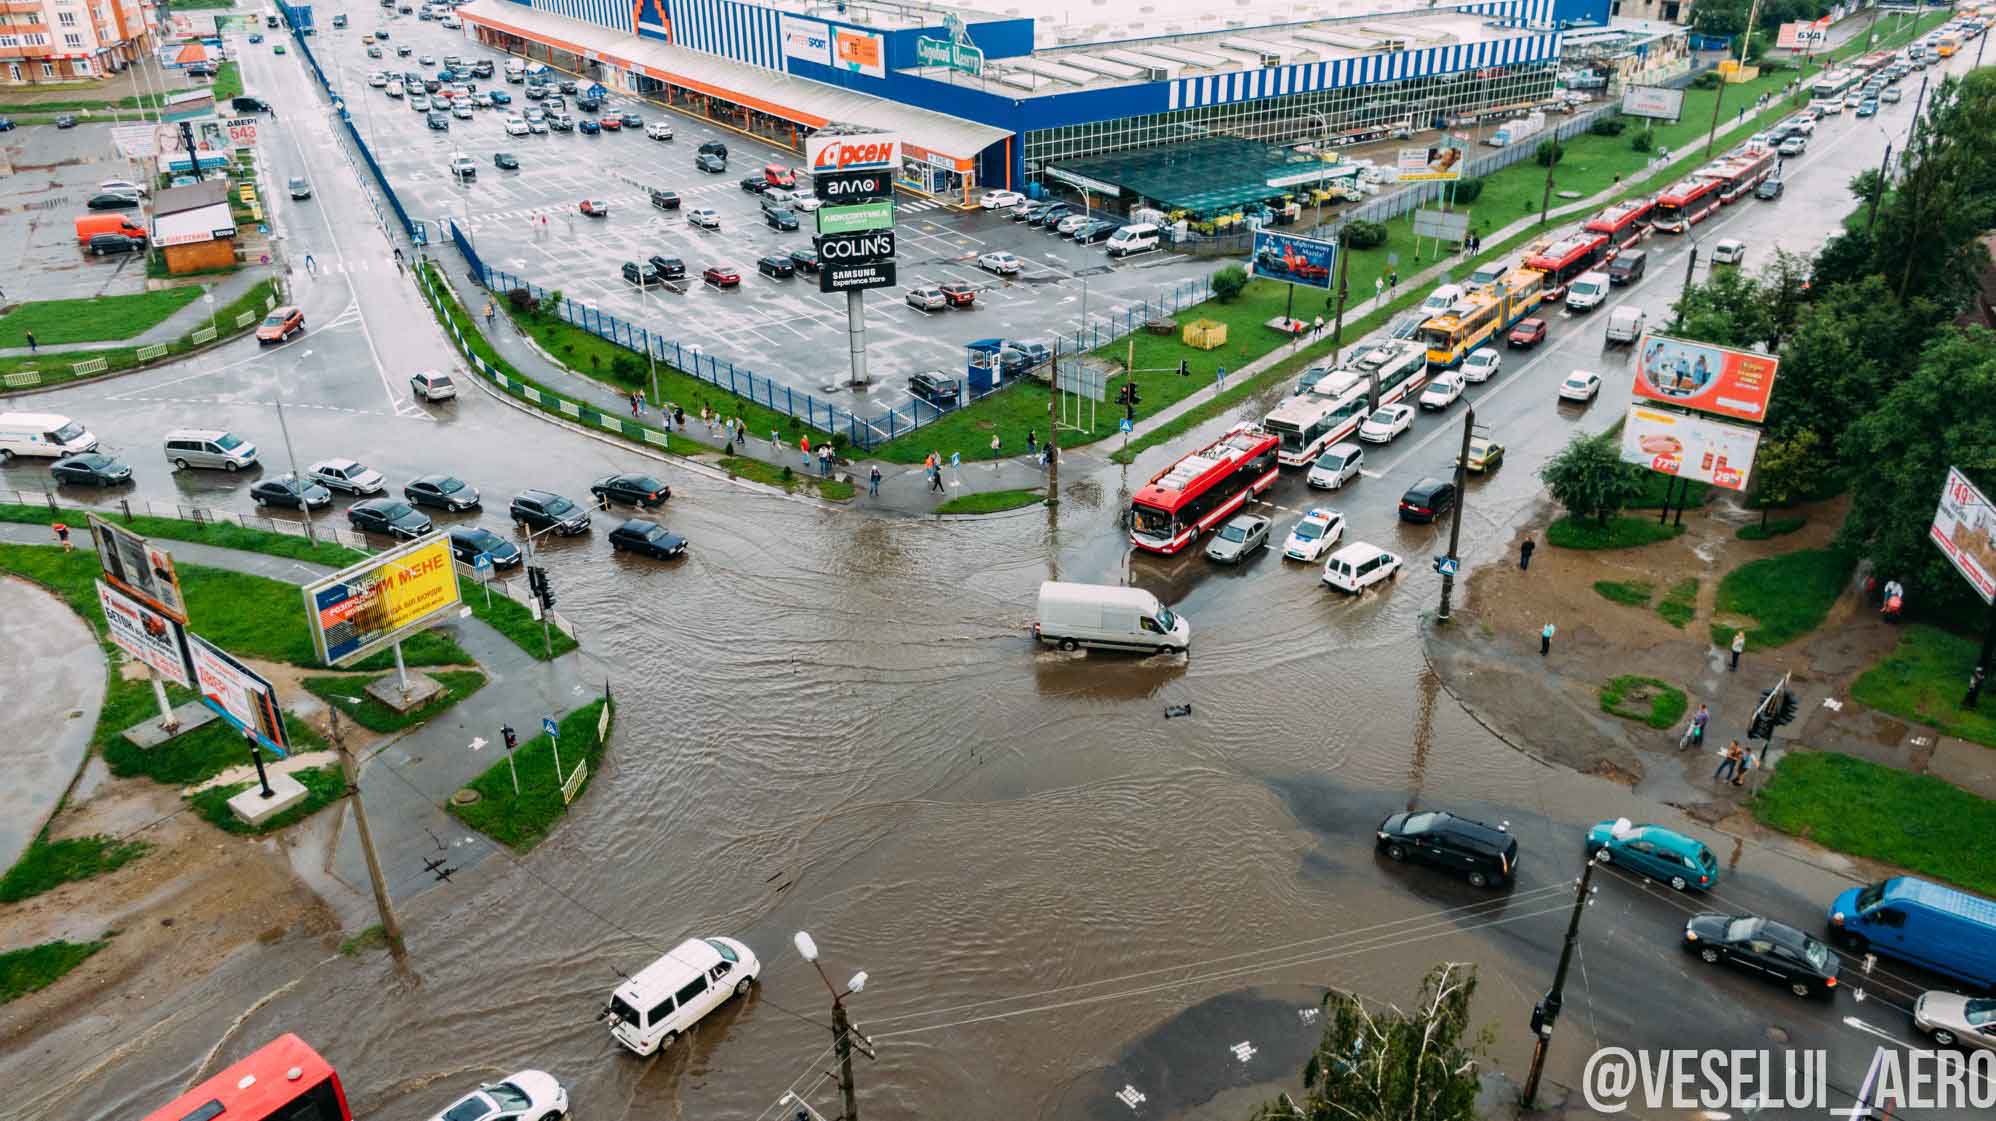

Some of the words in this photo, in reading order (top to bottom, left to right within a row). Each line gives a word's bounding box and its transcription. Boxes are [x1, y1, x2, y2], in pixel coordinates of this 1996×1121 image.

[229, 127, 257, 140] 543
[822, 233, 891, 259] COLIN'S
[832, 268, 876, 280] SAMSUNG
[832, 277, 868, 287] Experience
[869, 275, 886, 284] Store
